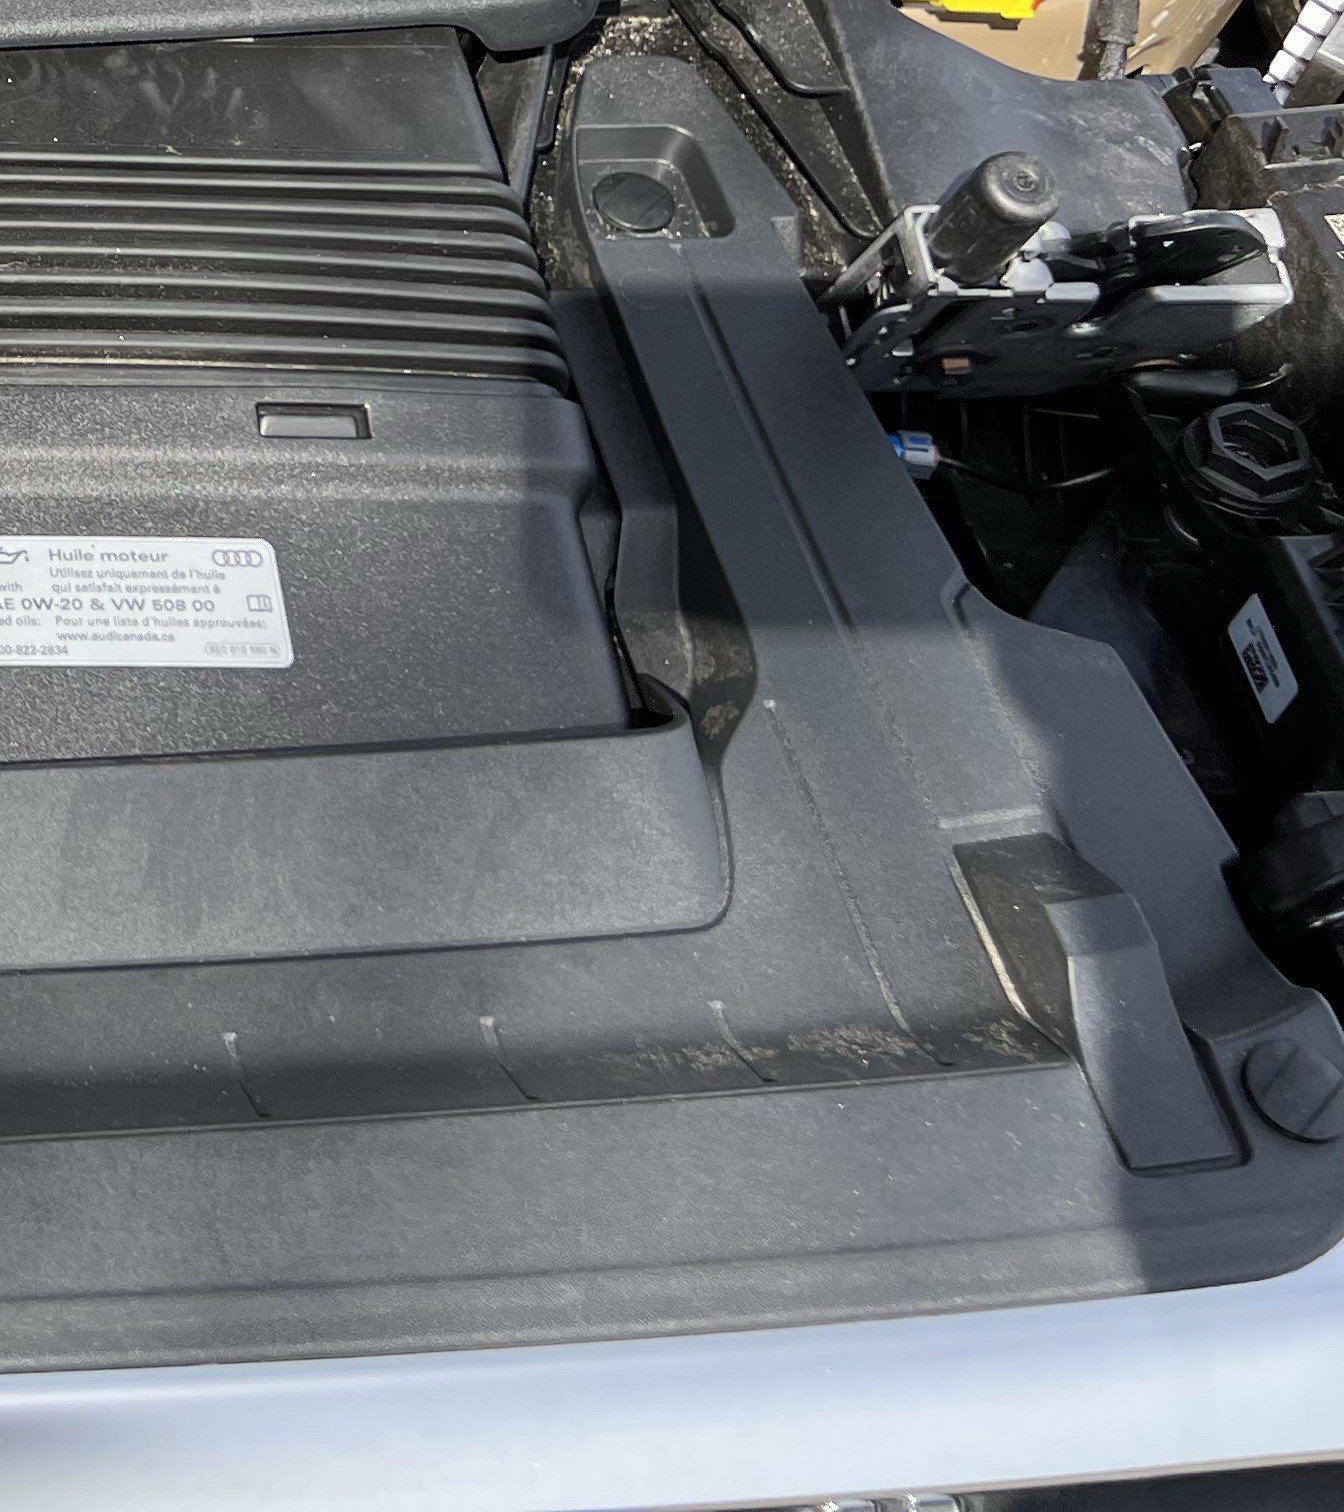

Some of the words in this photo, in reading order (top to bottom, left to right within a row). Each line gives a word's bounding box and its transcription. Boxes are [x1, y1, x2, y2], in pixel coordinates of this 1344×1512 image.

[48, 548, 95, 562] Huile
[100, 549, 169, 562] moteur
[49, 566, 93, 578] Utilisez
[96, 568, 169, 580] uniquement
[171, 568, 186, 579] de
[51, 582, 72, 594] qui
[74, 582, 123, 593] satisfait
[21, 597, 83, 611] 0W-20
[89, 598, 105, 611] &
[111, 598, 145, 611] VW
[152, 598, 186, 612] 508
[191, 599, 215, 612] 00
[55, 615, 84, 627] Pour
[87, 617, 110, 627] une
[113, 615, 139, 627] liste
[56, 632, 175, 643] www.audicanada.ca
